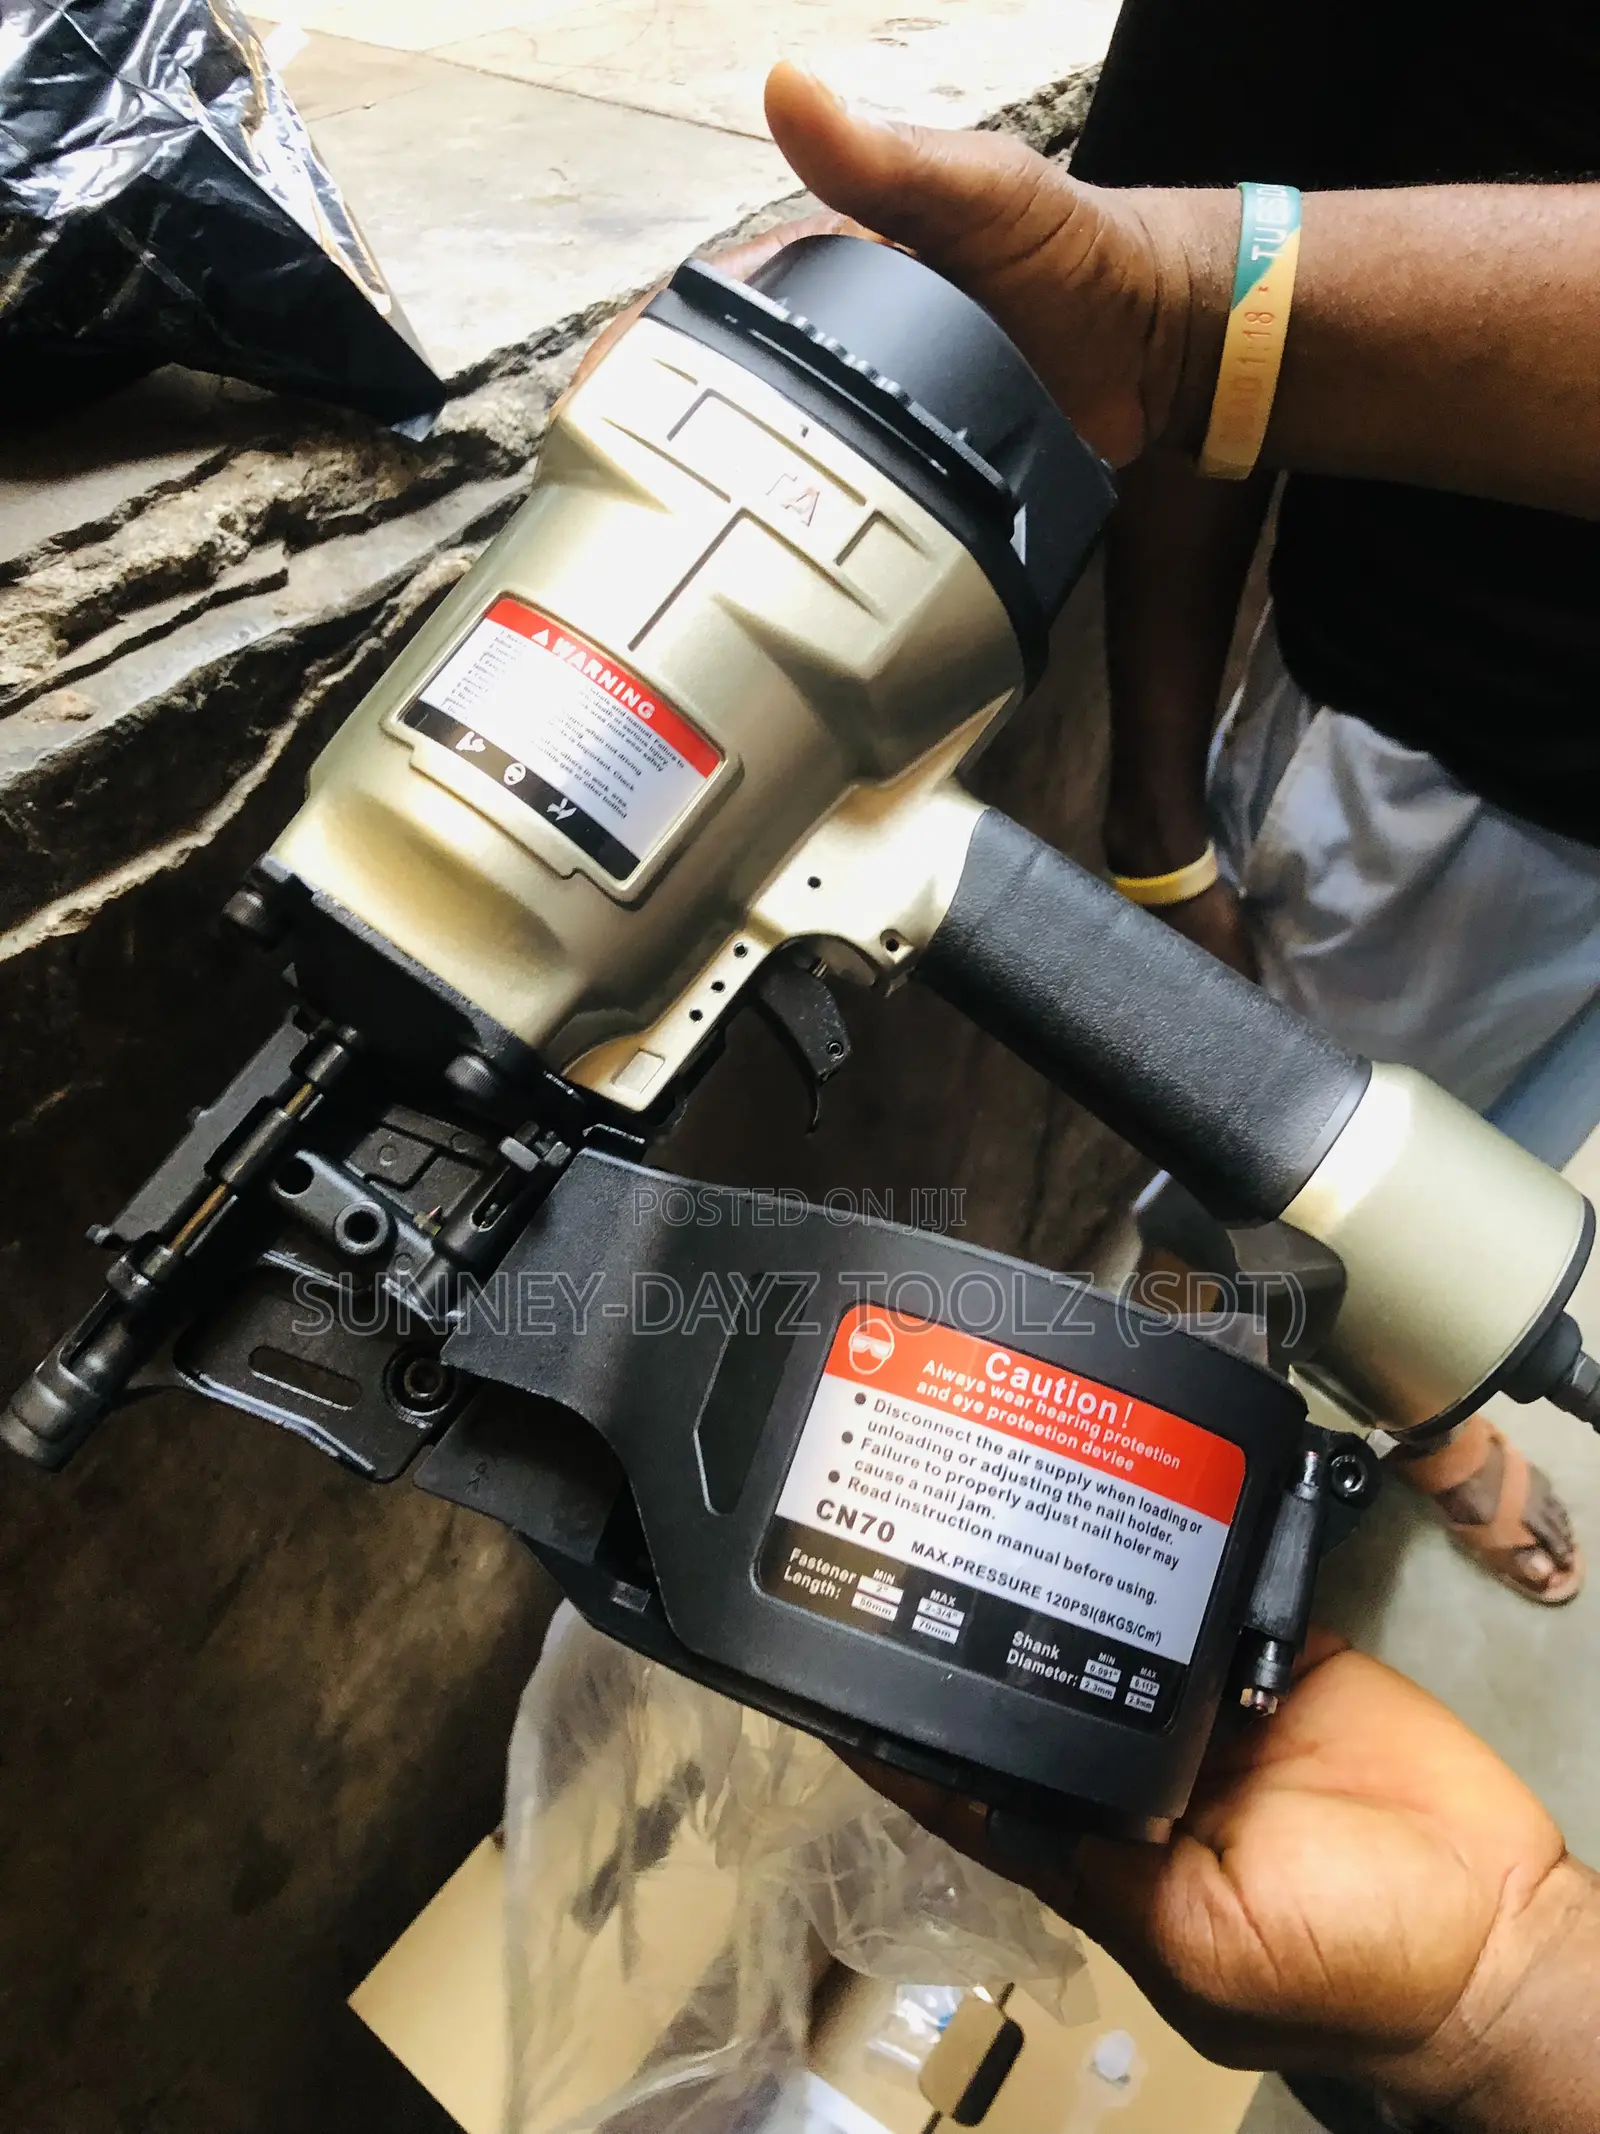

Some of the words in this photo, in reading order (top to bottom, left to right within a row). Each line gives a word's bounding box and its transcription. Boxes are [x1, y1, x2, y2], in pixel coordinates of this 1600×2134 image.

[551, 635, 656, 720] WARNING
[915, 1375, 951, 1403] and
[950, 1392, 985, 1418] eye
[921, 1356, 987, 1397] Always
[988, 1383, 1032, 1410] wear
[1033, 1398, 1102, 1440] hearing
[853, 1457, 905, 1486] cause
[907, 1478, 918, 1491] a
[922, 1480, 956, 1505] nail
[956, 1493, 998, 1523] jam.
[860, 1436, 922, 1471] Failure
[923, 1459, 942, 1477] to
[944, 1466, 1022, 1510] properly
[1023, 1495, 1080, 1531] adjust
[1080, 1517, 1112, 1541] nail
[1112, 1530, 1152, 1557] holer
[1151, 1549, 1179, 1572] may
[866, 1416, 954, 1462] unloading
[957, 1451, 977, 1468] or
[978, 1456, 1064, 1503] adjusting
[1065, 1489, 1094, 1512] the
[1095, 1501, 1125, 1525] nail
[1126, 1513, 1176, 1545] holder.
[873, 1395, 973, 1446] Disconnect
[975, 1433, 1005, 1455] the
[1006, 1444, 1033, 1465] air
[1032, 1455, 1093, 1492] supply
[1094, 1479, 1137, 1508] when
[1136, 1495, 1189, 1532] loading
[1188, 1520, 1203, 1534] or
[781, 1564, 842, 1602] Length:
[788, 1546, 858, 1585] Fastener
[872, 1568, 896, 1585] MIN
[929, 1588, 957, 1608] MAX
[813, 1495, 897, 1544] CN70
[909, 1539, 1043, 1600] MAX.PRESSURE
[846, 1475, 891, 1504] Read
[894, 1491, 994, 1541] instruction
[995, 1530, 1061, 1566] manual
[1061, 1554, 1115, 1587] before
[1114, 1574, 1160, 1607] using.
[1005, 1647, 1079, 1687] Diameter:
[1010, 1629, 1061, 1661] Shank
[1097, 1651, 1116, 1666] MIN
[1139, 1666, 1157, 1680] MAX
